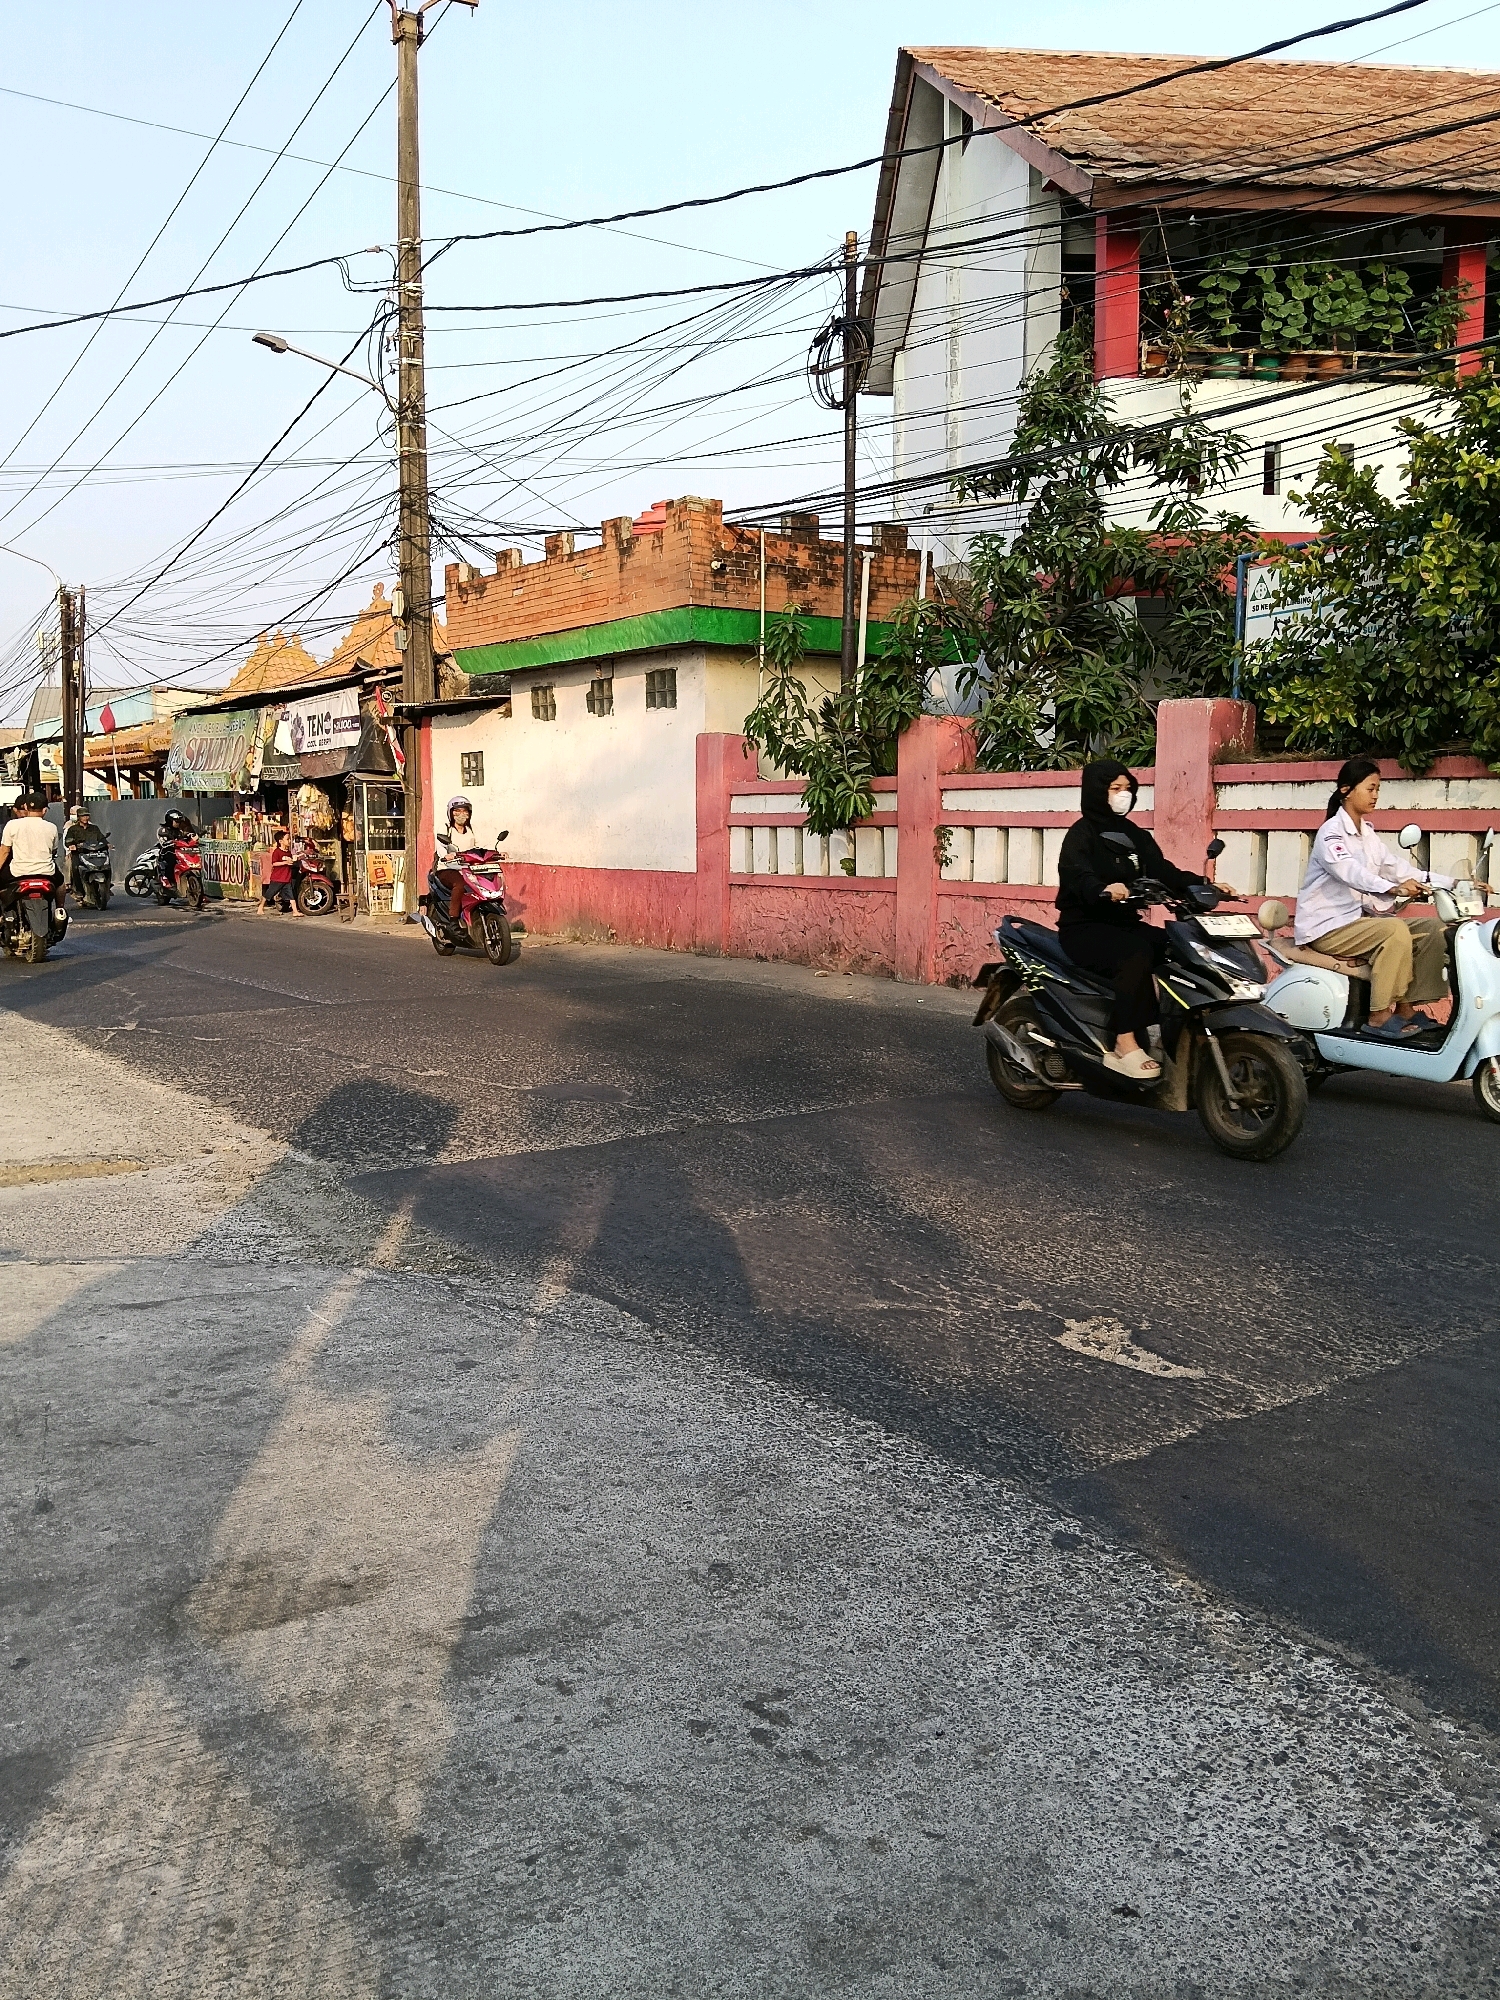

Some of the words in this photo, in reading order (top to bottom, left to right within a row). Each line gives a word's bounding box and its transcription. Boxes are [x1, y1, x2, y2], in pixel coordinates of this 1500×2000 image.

[1252, 604, 1260, 612] SD
[182, 734, 246, 772] SEKECO
[203, 853, 245, 885] SEKECO
